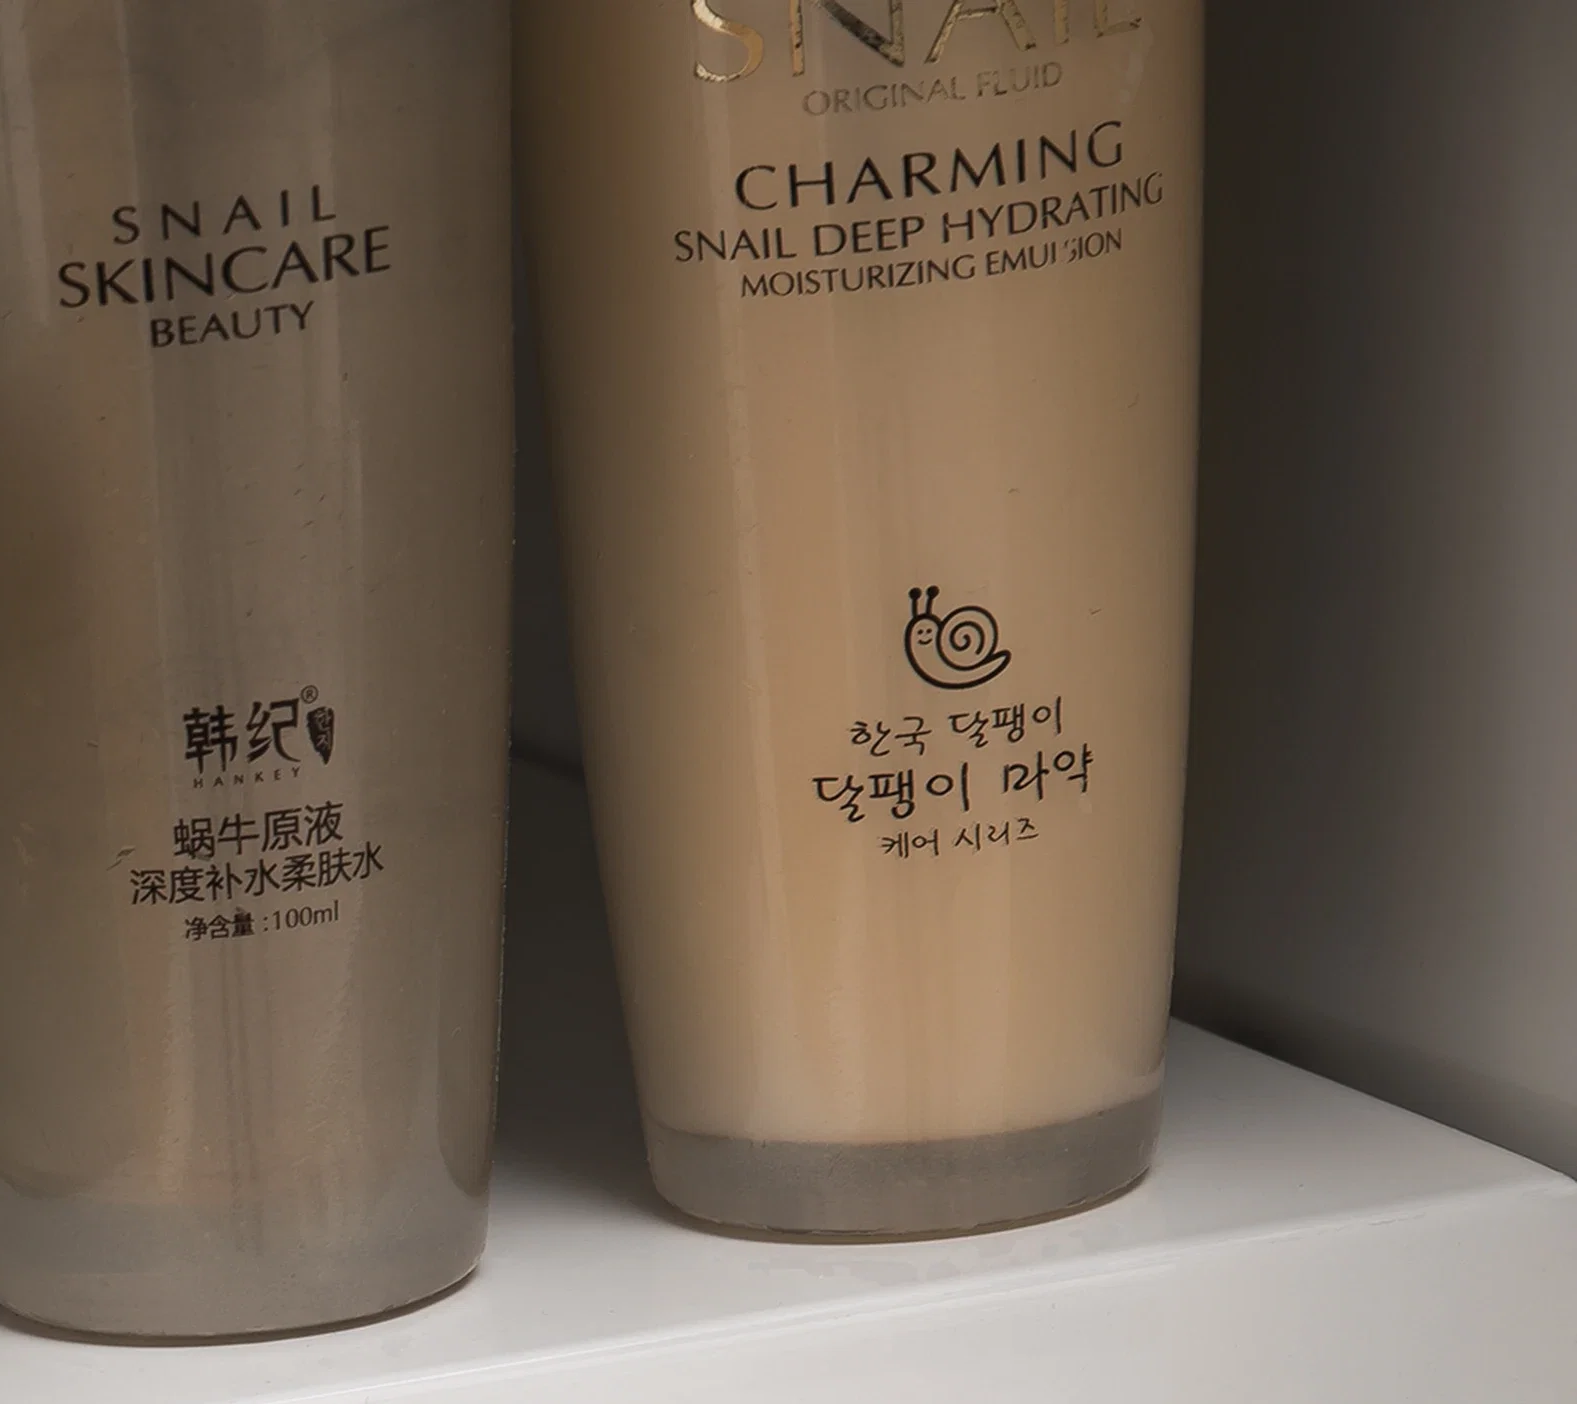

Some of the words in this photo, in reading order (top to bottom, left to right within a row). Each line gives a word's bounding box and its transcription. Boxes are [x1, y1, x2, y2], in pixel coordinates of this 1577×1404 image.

[801, 76, 966, 117] ORIGINAL
[975, 61, 1063, 98] FLUID
[734, 119, 1125, 211] CHARMING
[111, 184, 337, 245] SNAIL
[673, 226, 798, 263] SNAIL
[812, 214, 926, 258] DEEP
[941, 171, 1165, 246] HYDRATING
[57, 224, 392, 309] SKINCARE
[740, 253, 977, 299] MOISTURIZING
[149, 300, 315, 349] BEAUTY
[849, 715, 933, 757] 한국
[947, 696, 1062, 749] 달팽이
[192, 766, 301, 789] HANKEY
[812, 761, 970, 823] 달팽이
[1002, 743, 1094, 802] 마약
[173, 800, 344, 860] 蜗牛原液
[880, 828, 940, 859] 케어
[954, 817, 1039, 852] 시리즈
[129, 841, 385, 905] 深度补水柔肤水
